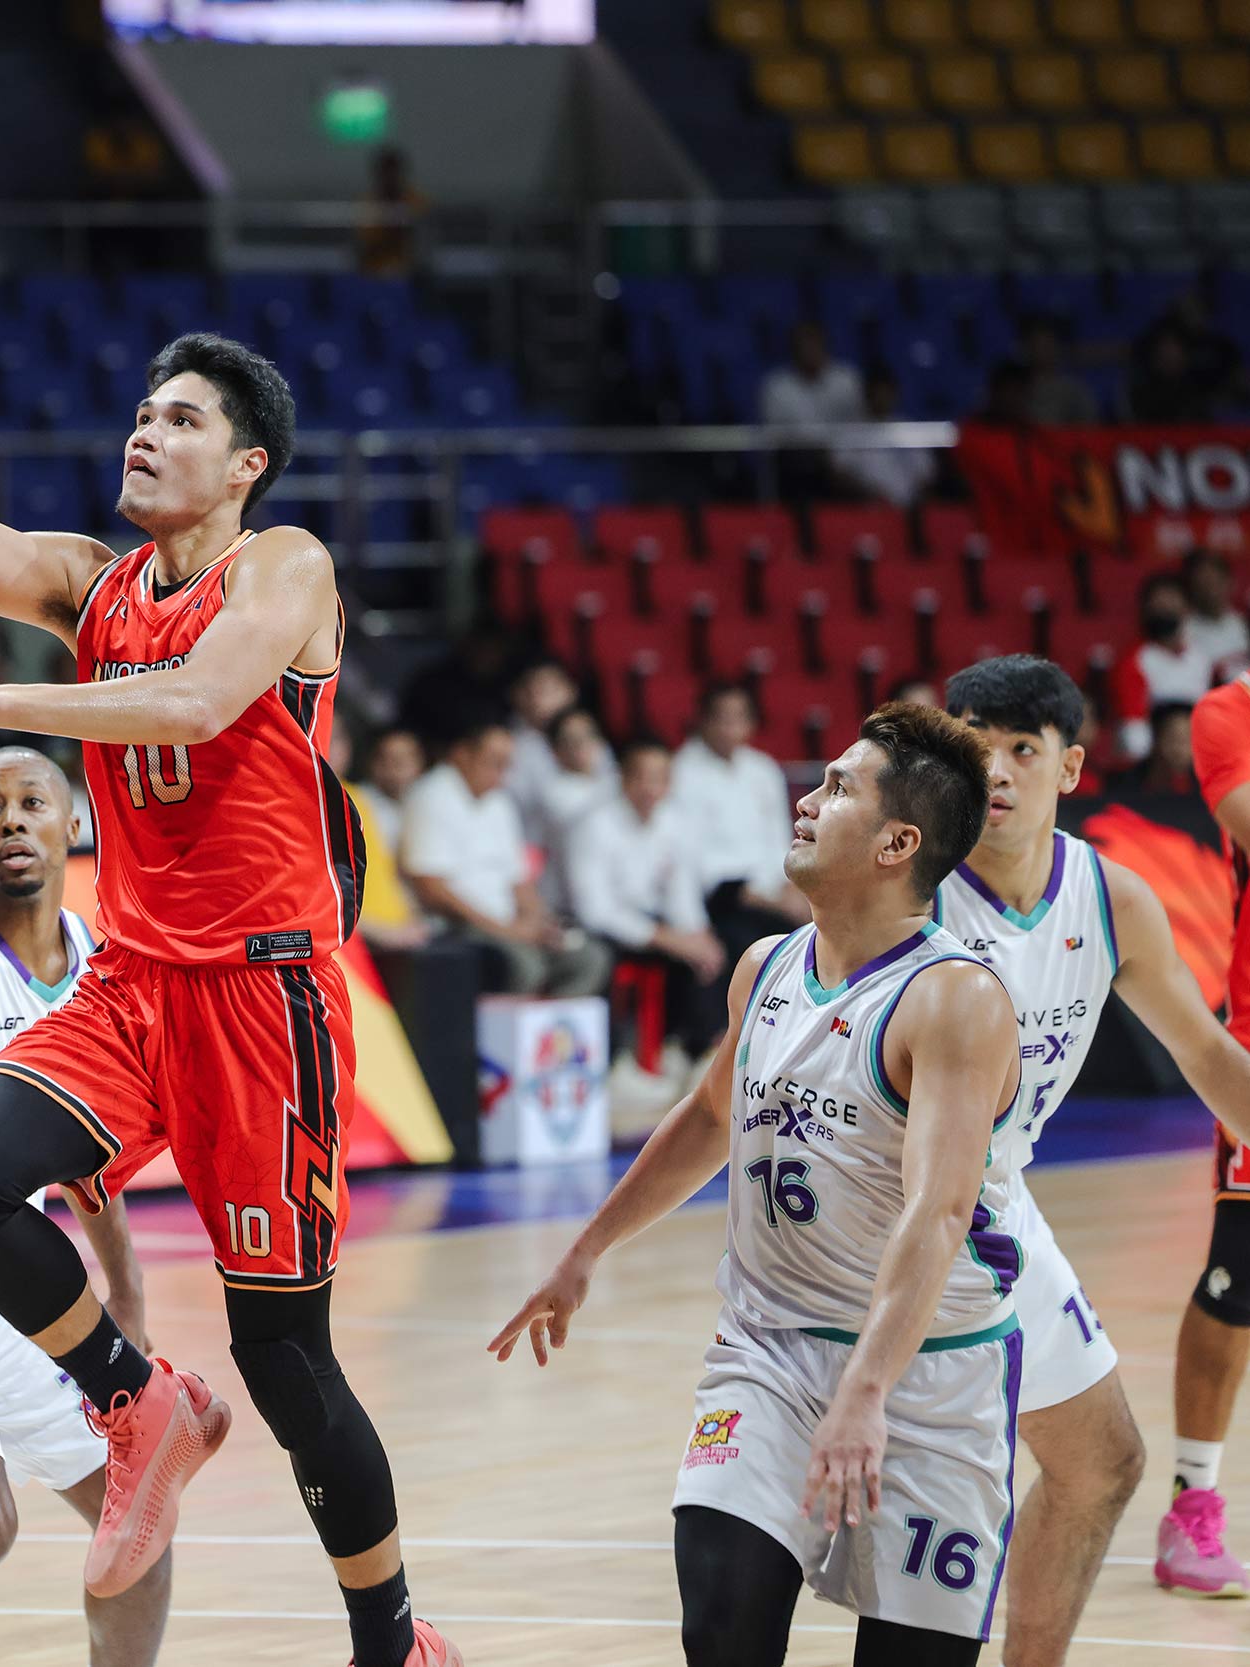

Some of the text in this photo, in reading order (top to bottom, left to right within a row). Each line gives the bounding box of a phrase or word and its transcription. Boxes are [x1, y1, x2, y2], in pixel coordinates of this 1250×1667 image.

[123, 744, 193, 809] 10
[1016, 999, 1088, 1030] NVERG
[1018, 1075, 1060, 1135] 5
[744, 1155, 820, 1229] 16
[224, 1200, 271, 1259] 10
[1059, 1286, 1105, 1348] 1
[901, 1513, 983, 1594] 16
